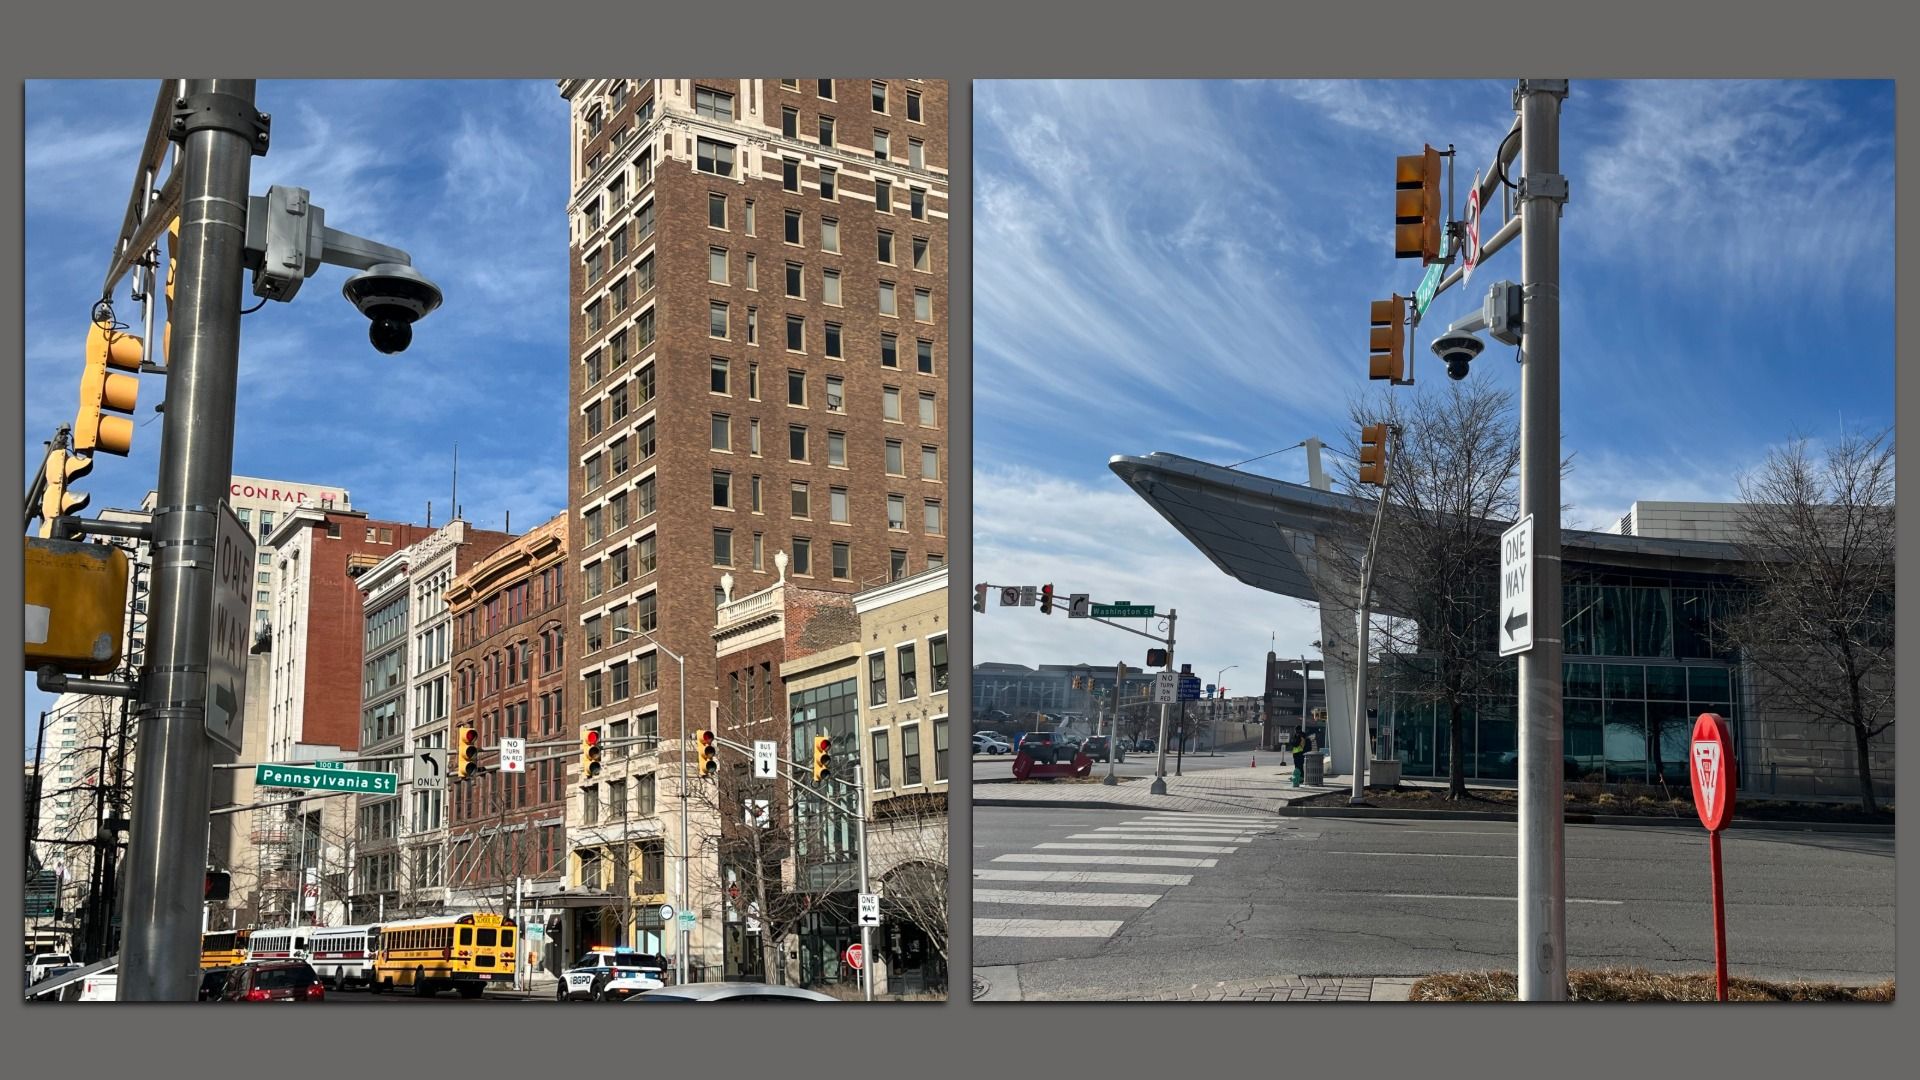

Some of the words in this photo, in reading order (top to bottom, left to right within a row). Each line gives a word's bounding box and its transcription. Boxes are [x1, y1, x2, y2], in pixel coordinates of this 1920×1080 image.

[230, 484, 308, 503] CONRAD
[1505, 530, 1526, 566] ONE
[222, 535, 250, 605] ONE
[1505, 563, 1527, 599] WAY
[1093, 607, 1141, 616] Washington
[216, 603, 246, 671] WAY
[263, 769, 369, 788] Pennsylvania
[374, 777, 390, 789] St
[417, 777, 441, 786] ONLY
[861, 896, 875, 904] ONE
[572, 975, 591, 985] BGPD
